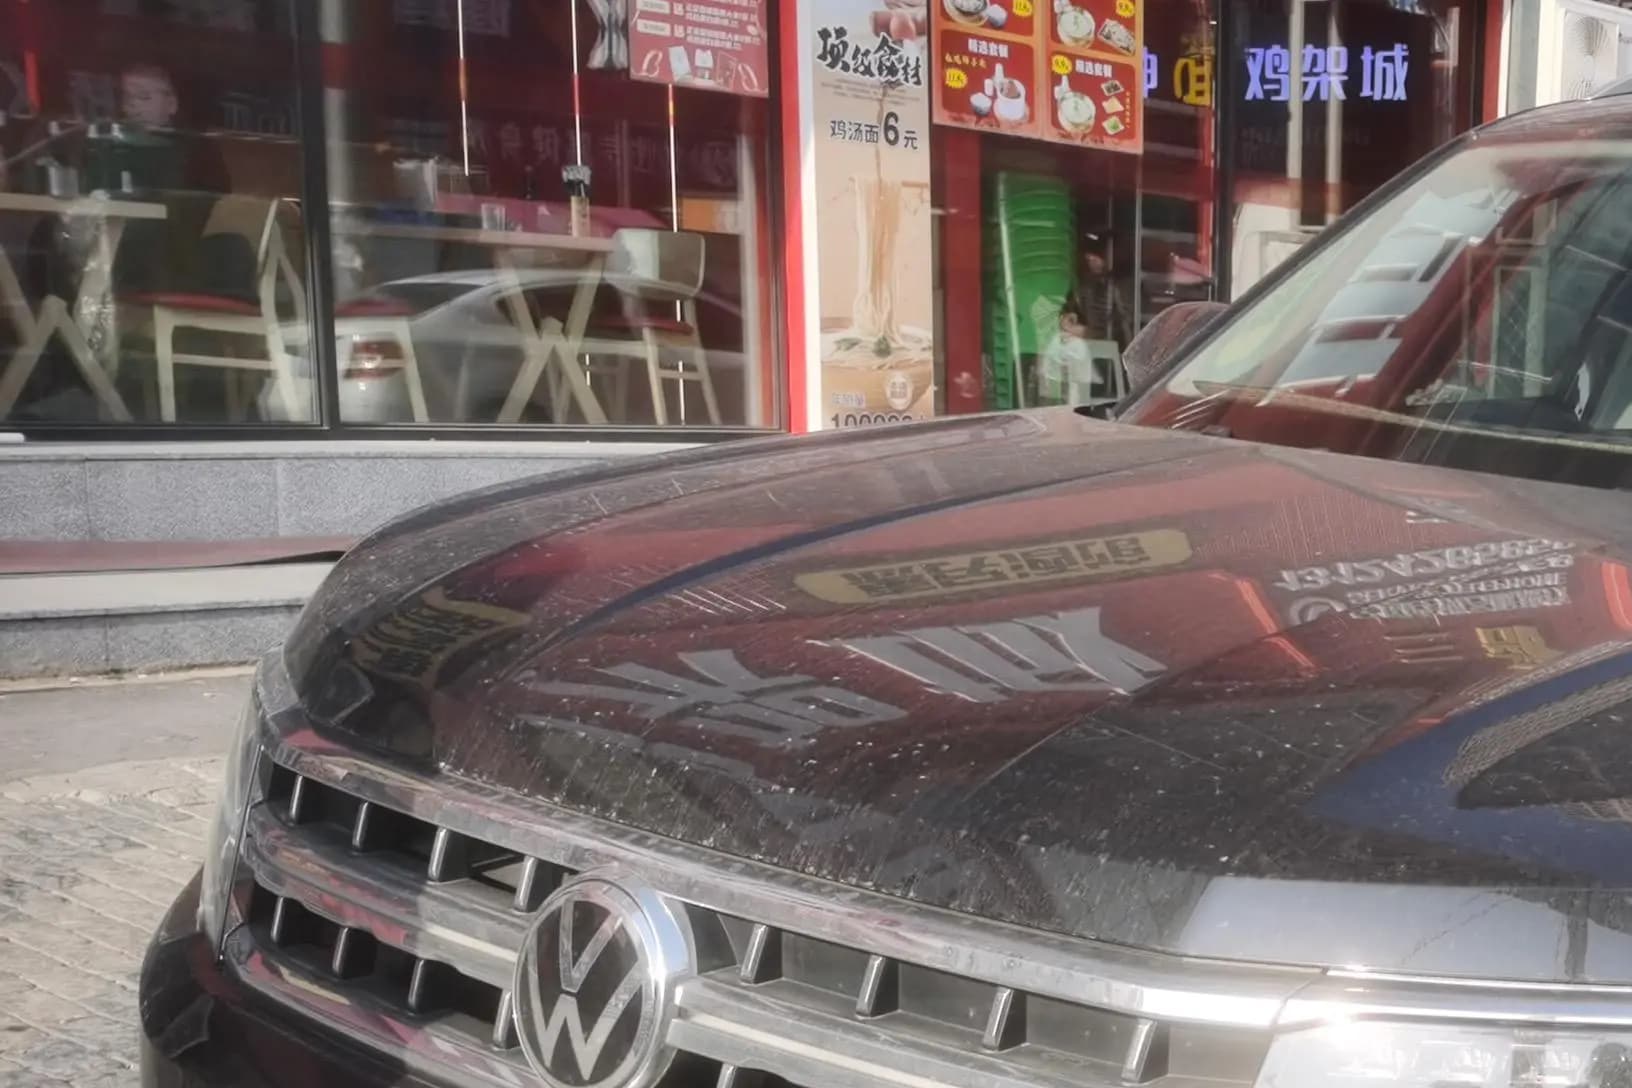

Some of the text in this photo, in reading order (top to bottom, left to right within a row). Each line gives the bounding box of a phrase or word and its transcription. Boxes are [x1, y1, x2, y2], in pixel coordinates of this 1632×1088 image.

[816, 26, 922, 86] 顶级食材
[1244, 43, 1410, 101] 鸡架城
